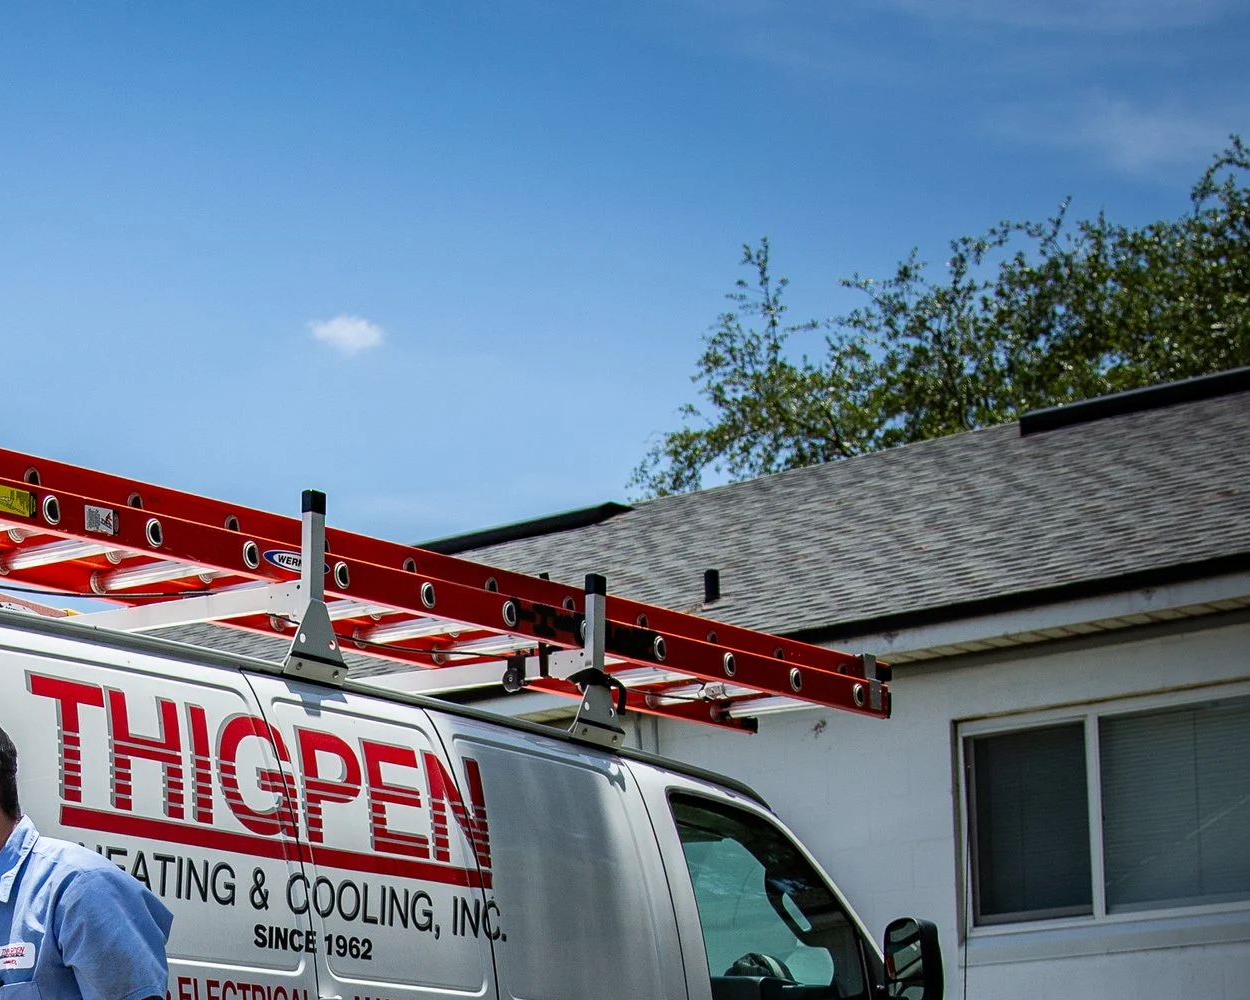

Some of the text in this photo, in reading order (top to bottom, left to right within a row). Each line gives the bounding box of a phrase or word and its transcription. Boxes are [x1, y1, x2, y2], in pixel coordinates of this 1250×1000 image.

[25, 669, 492, 868] THIGPEN
[78, 842, 508, 942] ATING & COOLING, INC.
[253, 923, 373, 961] SINCE 1962
